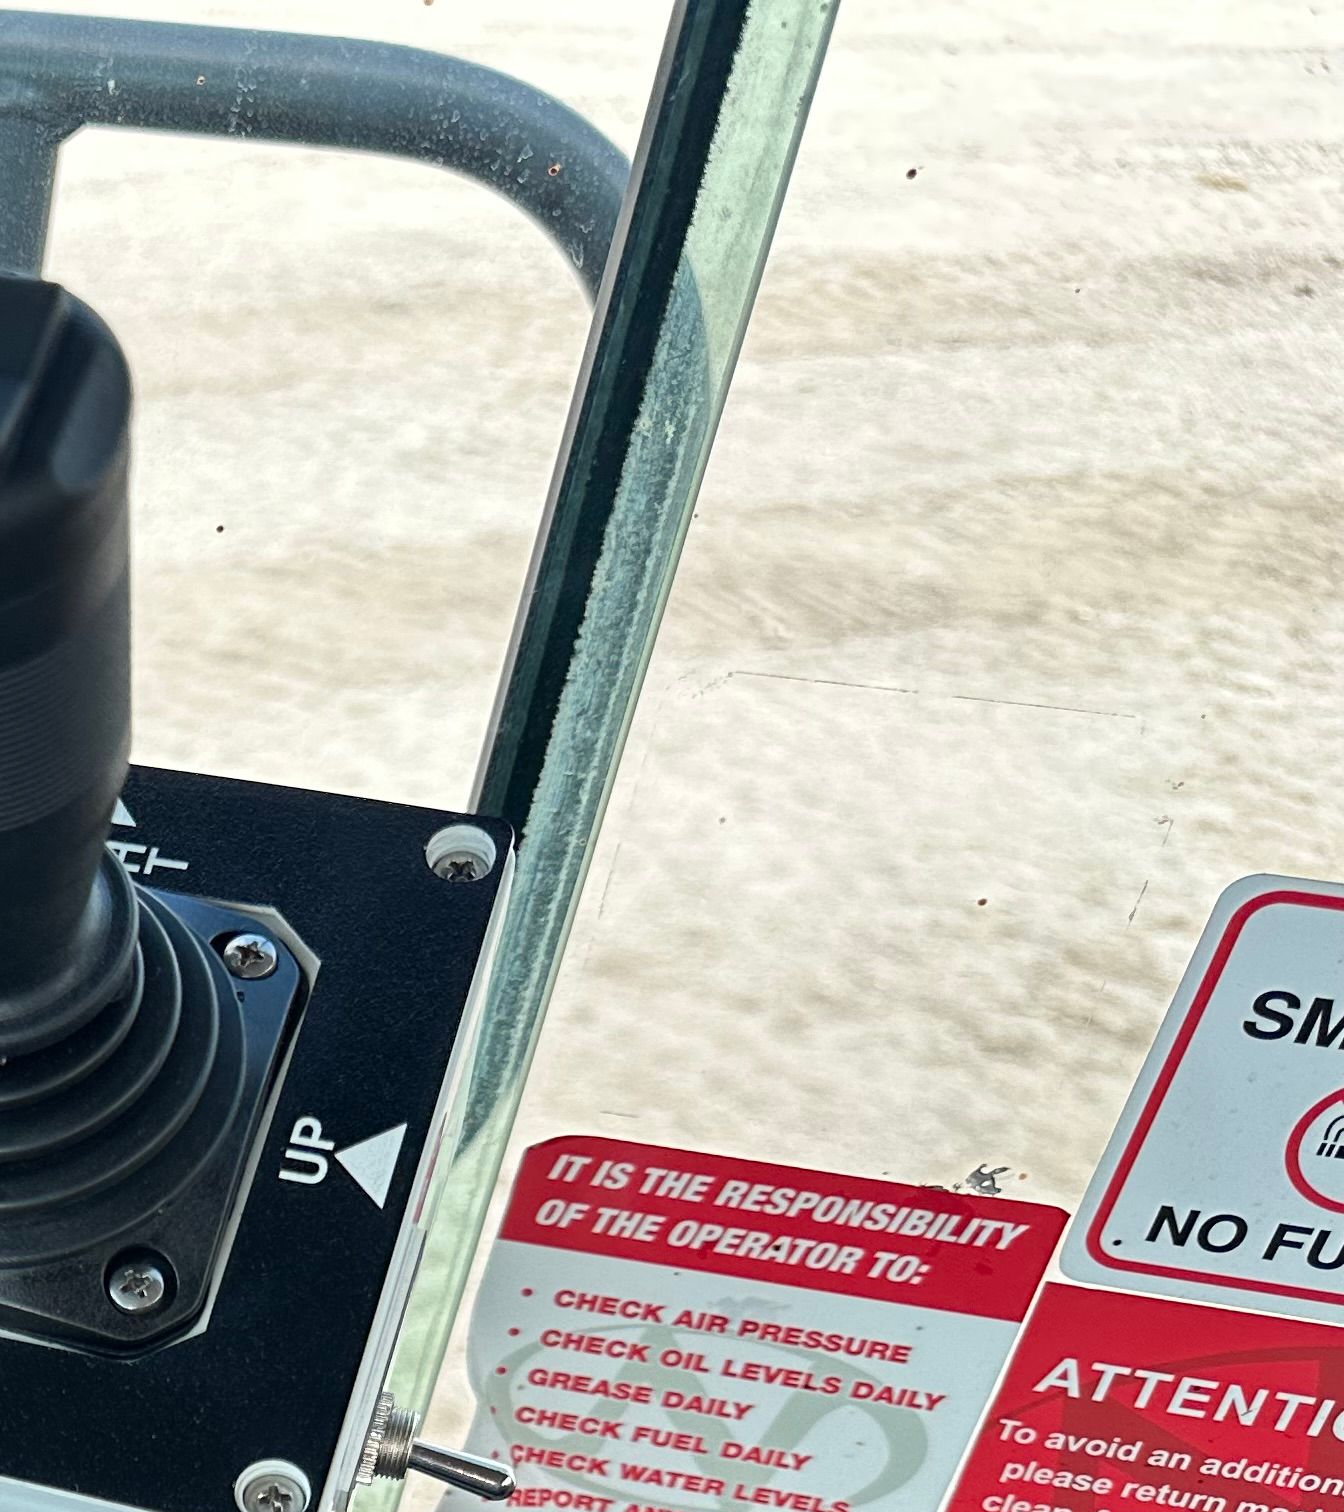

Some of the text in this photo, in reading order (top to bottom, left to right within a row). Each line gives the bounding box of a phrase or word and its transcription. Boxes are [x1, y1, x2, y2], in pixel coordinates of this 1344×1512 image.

[278, 1114, 337, 1186] UP
[547, 1154, 1030, 1250] IT IS THE RESPONSIBILITY
[1144, 1204, 1344, 1270] NO FU
[535, 1199, 932, 1285] OF THE OPERATOR TO:
[554, 1289, 913, 1364] CHECK AIR PRESSURE
[527, 1368, 754, 1420] GREASE DAILY
[540, 1329, 947, 1411] CHECK OIL LEVELS DAILY
[1032, 1357, 1344, 1443] ATTENTI
[510, 1444, 611, 1477] CHECK
[620, 1462, 726, 1495] WATER
[515, 1406, 813, 1471] CHECK FUEL DAILY
[998, 1418, 1344, 1499] To avoid an addition
[999, 1460, 1113, 1496] please
